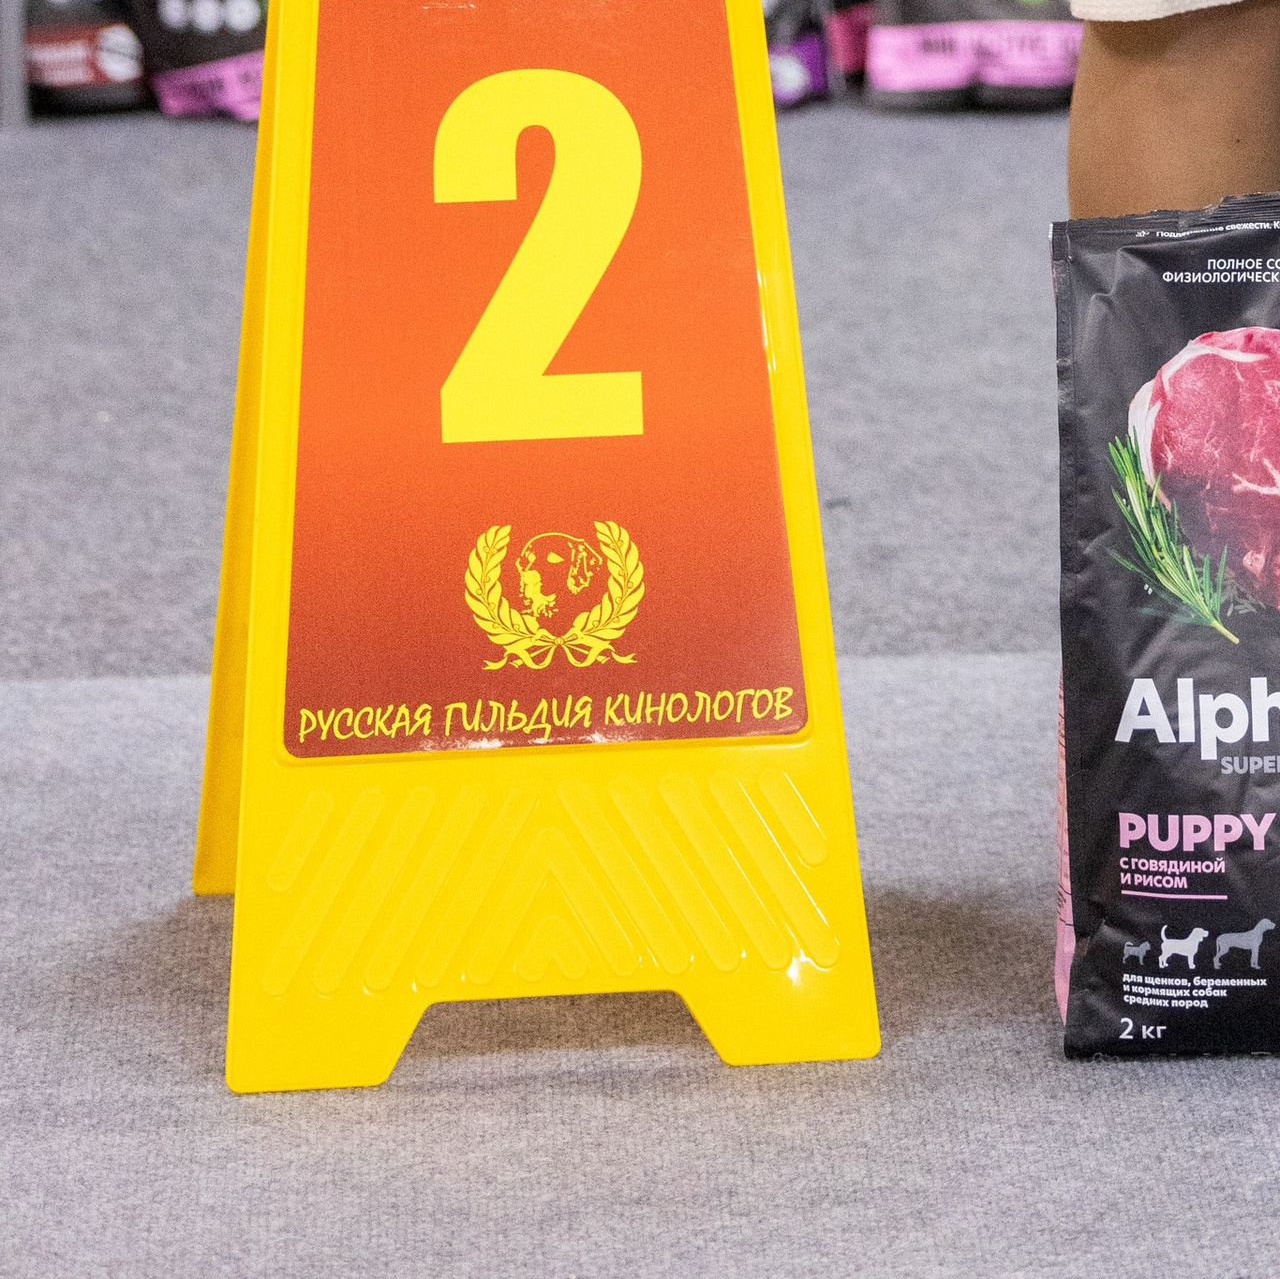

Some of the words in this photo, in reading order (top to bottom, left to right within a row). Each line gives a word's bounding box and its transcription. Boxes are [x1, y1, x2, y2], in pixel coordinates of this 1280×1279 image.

[1225, 221, 1272, 233] свежести.
[434, 68, 643, 443] 2
[1207, 258, 1263, 270] ПОЛНОЕ
[298, 703, 431, 744] РУССКАЯ
[444, 695, 593, 741] ГИЛЬДИЯ
[605, 687, 794, 726] КИНОЛОГОВ
[1118, 812, 1277, 852] PUPPY
[1119, 856, 1129, 869] С
[1131, 857, 1226, 875] ГОВЯДИНОЙ
[1120, 872, 1132, 885] И
[1134, 874, 1188, 889] РИСОМ
[1122, 973, 1143, 983] для
[1144, 975, 1192, 988] щенков,
[1193, 976, 1267, 988] беременных
[1123, 984, 1130, 992] и
[1132, 985, 1190, 998] кормящих
[1192, 986, 1228, 997] собак
[1123, 994, 1169, 1008] средних
[1171, 999, 1209, 1009] пород
[1119, 1017, 1134, 1039] 2
[1141, 1025, 1167, 1039] кг
